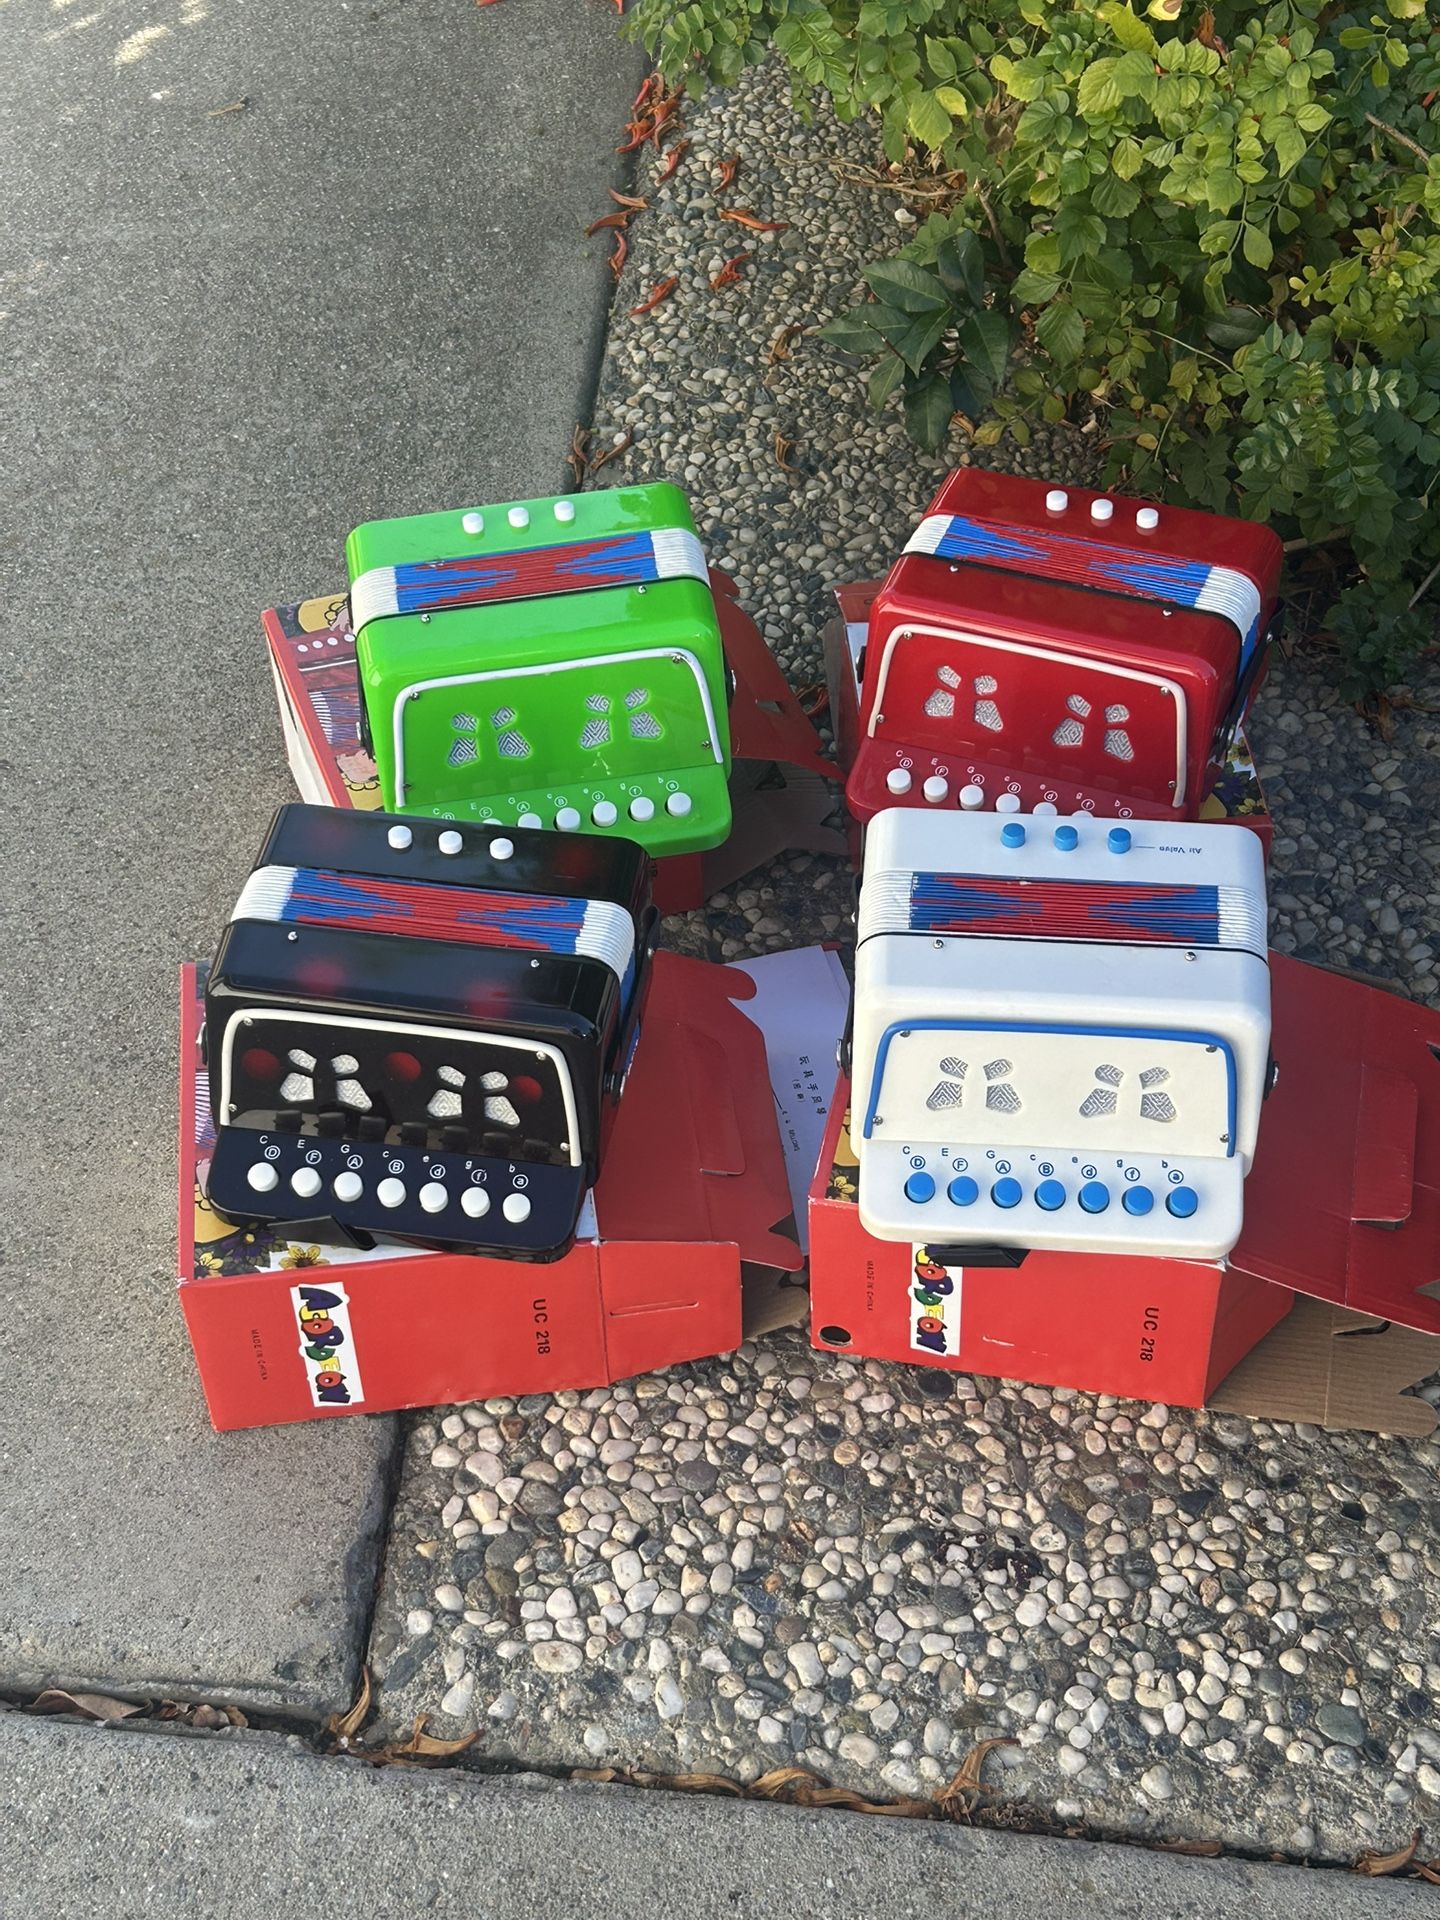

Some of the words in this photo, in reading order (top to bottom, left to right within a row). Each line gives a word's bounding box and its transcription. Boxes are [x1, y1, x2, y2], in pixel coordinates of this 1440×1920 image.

[931, 758, 938, 766] E
[470, 802, 477, 810] E
[1159, 846, 1186, 854] Valve
[260, 1135, 268, 1144] C
[297, 1139, 305, 1148] E
[340, 1144, 350, 1153] G
[465, 1161, 472, 1169] g
[509, 1164, 515, 1173] b
[902, 1146, 911, 1154] C
[942, 1148, 949, 1156] E
[986, 1150, 995, 1159] G
[1116, 1159, 1123, 1168] g
[1162, 1160, 1168, 1168] b
[533, 1298, 548, 1324] UC
[1143, 1307, 1160, 1331] UC
[251, 1329, 262, 1349] MADE
[536, 1330, 551, 1355] 218
[1140, 1337, 1155, 1361] 218
